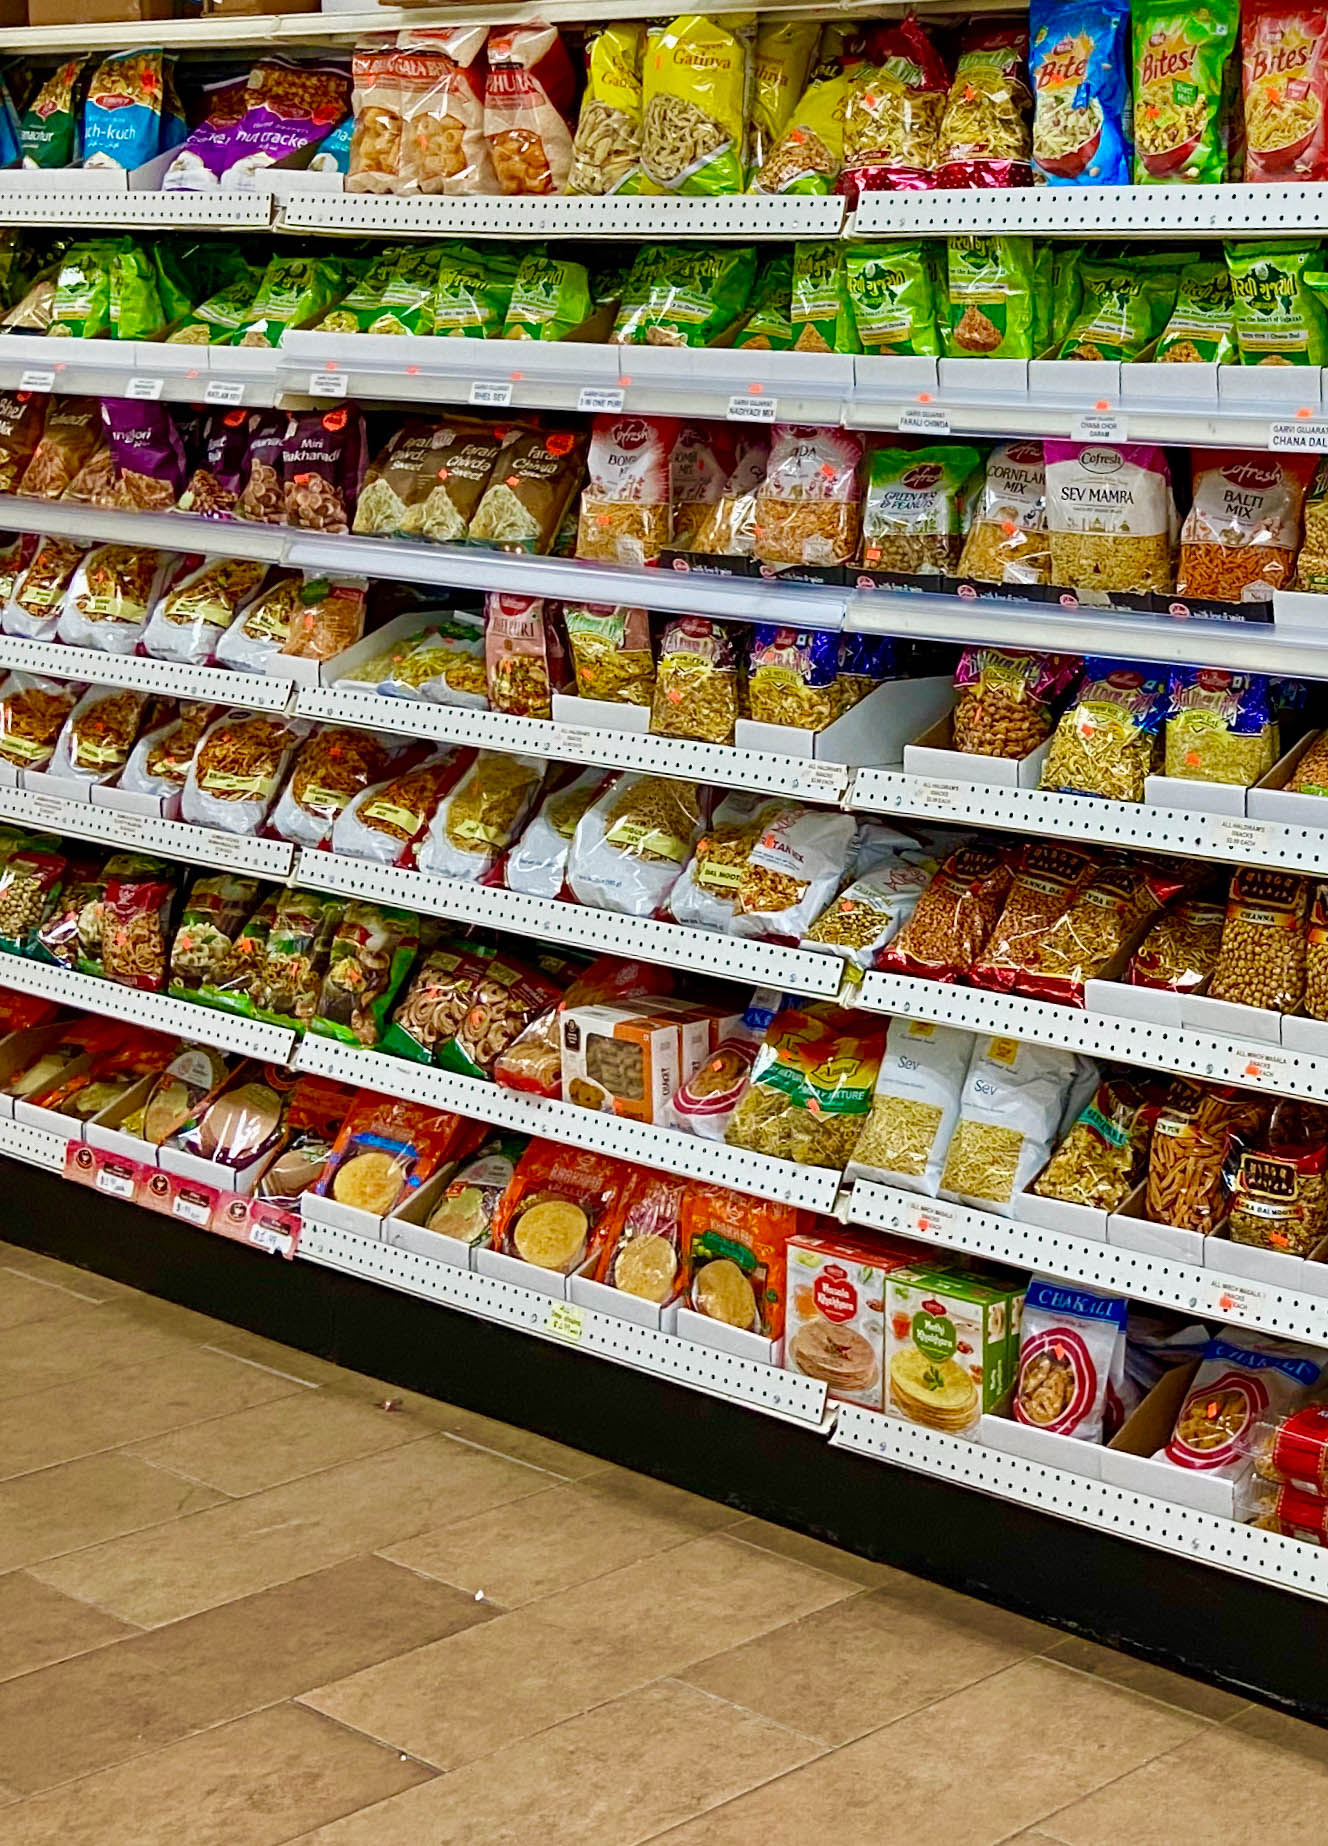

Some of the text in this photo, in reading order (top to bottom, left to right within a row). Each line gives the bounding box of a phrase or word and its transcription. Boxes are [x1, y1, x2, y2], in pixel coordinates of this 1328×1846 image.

[1143, 44, 1197, 87] Bites!
[1253, 40, 1317, 82] Bites!
[301, 438, 324, 450] Mini
[1273, 435, 1328, 448] CHANA DAL
[1080, 451, 1122, 466] Cofresh
[1219, 462, 1282, 484] Cofresh
[1003, 482, 1028, 495] MIX
[1061, 487, 1134, 505] SEV MAMRA
[1224, 490, 1265, 508] BALTI
[1225, 504, 1253, 520] MIX
[898, 1056, 920, 1071] Sev
[975, 1080, 998, 1096] Sev
